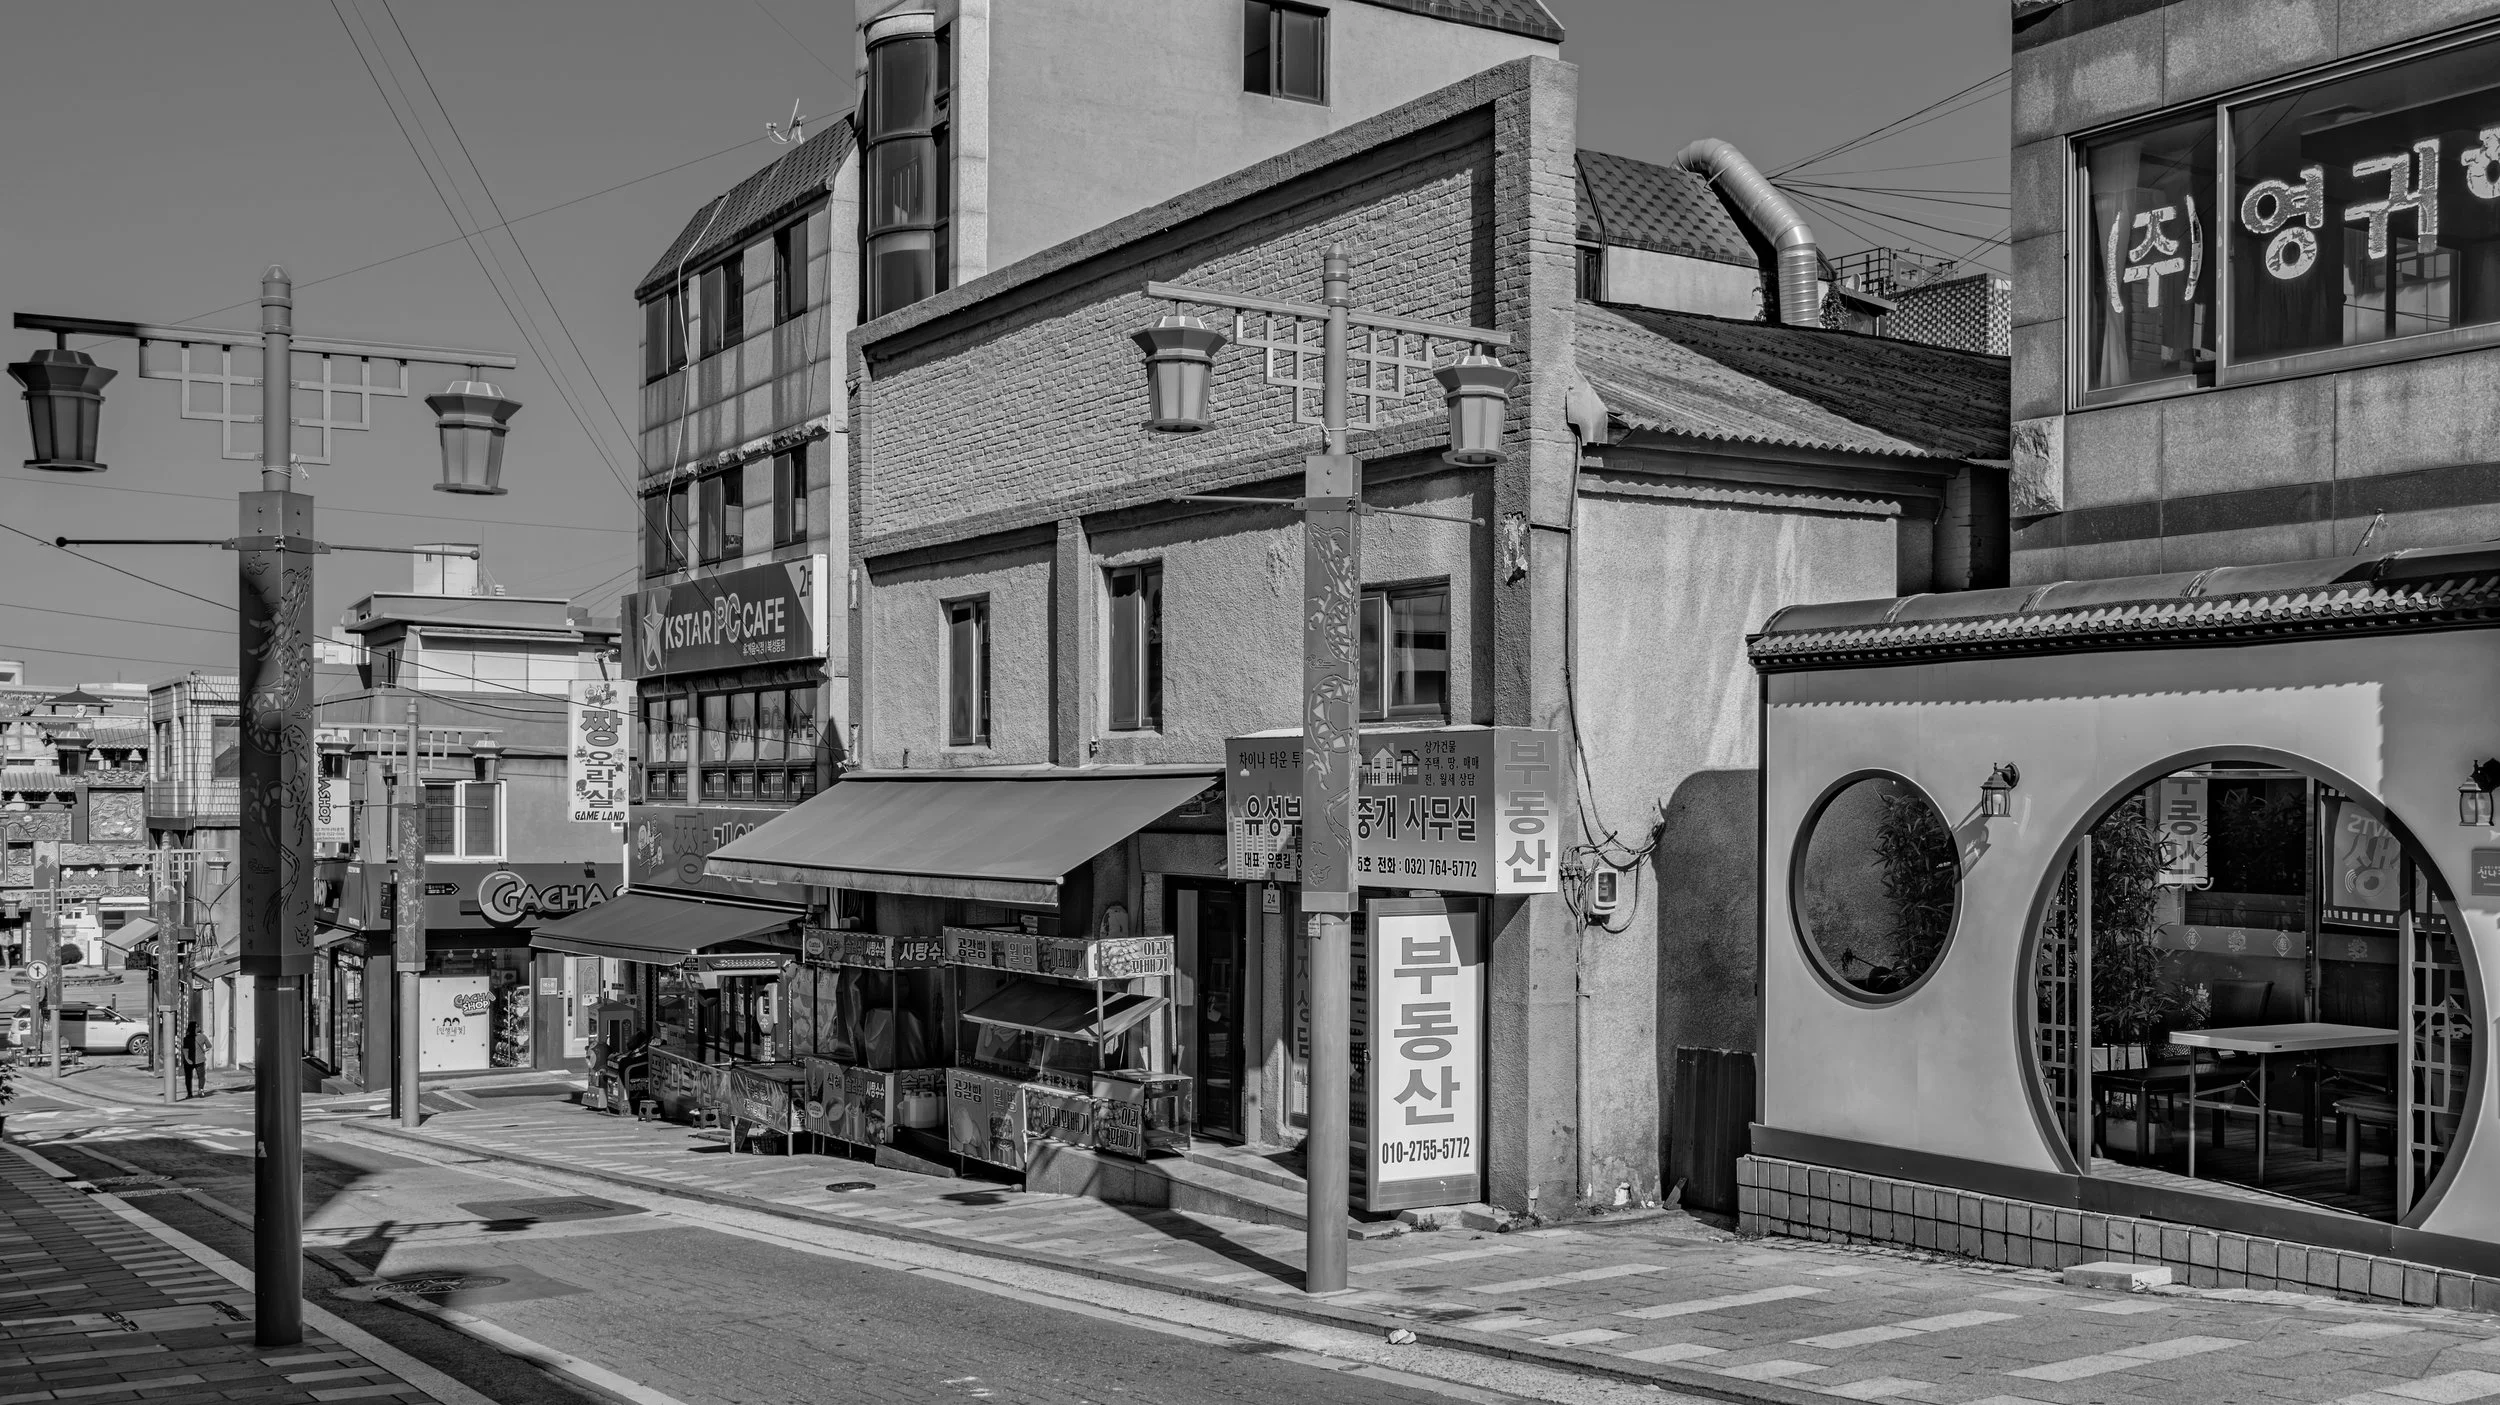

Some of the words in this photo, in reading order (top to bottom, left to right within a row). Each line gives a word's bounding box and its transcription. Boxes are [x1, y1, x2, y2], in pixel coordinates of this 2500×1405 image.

[799, 565, 812, 597] 2F
[664, 612, 712, 650] KSTAR
[714, 592, 742, 646] PC
[742, 596, 785, 638] CAFE
[1424, 740, 1456, 754] 상가건물
[1239, 751, 1266, 769] 차이나
[1269, 751, 1288, 769] 타운
[1459, 772, 1475, 787] 상담
[574, 811, 599, 821] GAME
[601, 811, 625, 821] LAND
[1404, 794, 1477, 842] 사무실
[1504, 740, 1551, 884] 부동산
[1429, 859, 1477, 877] 764-5772
[491, 881, 609, 916] GACHA
[1267, 893, 1276, 905] 24
[900, 942, 945, 961] 사탕수
[957, 936, 986, 959] 공갈빵
[453, 990, 497, 1006] GACHA
[462, 1000, 490, 1011] SHOP
[1393, 935, 1461, 1126] 부동산
[953, 1078, 982, 1103] 공갈빵
[1382, 1136, 1470, 1164] 010-2755-5772
